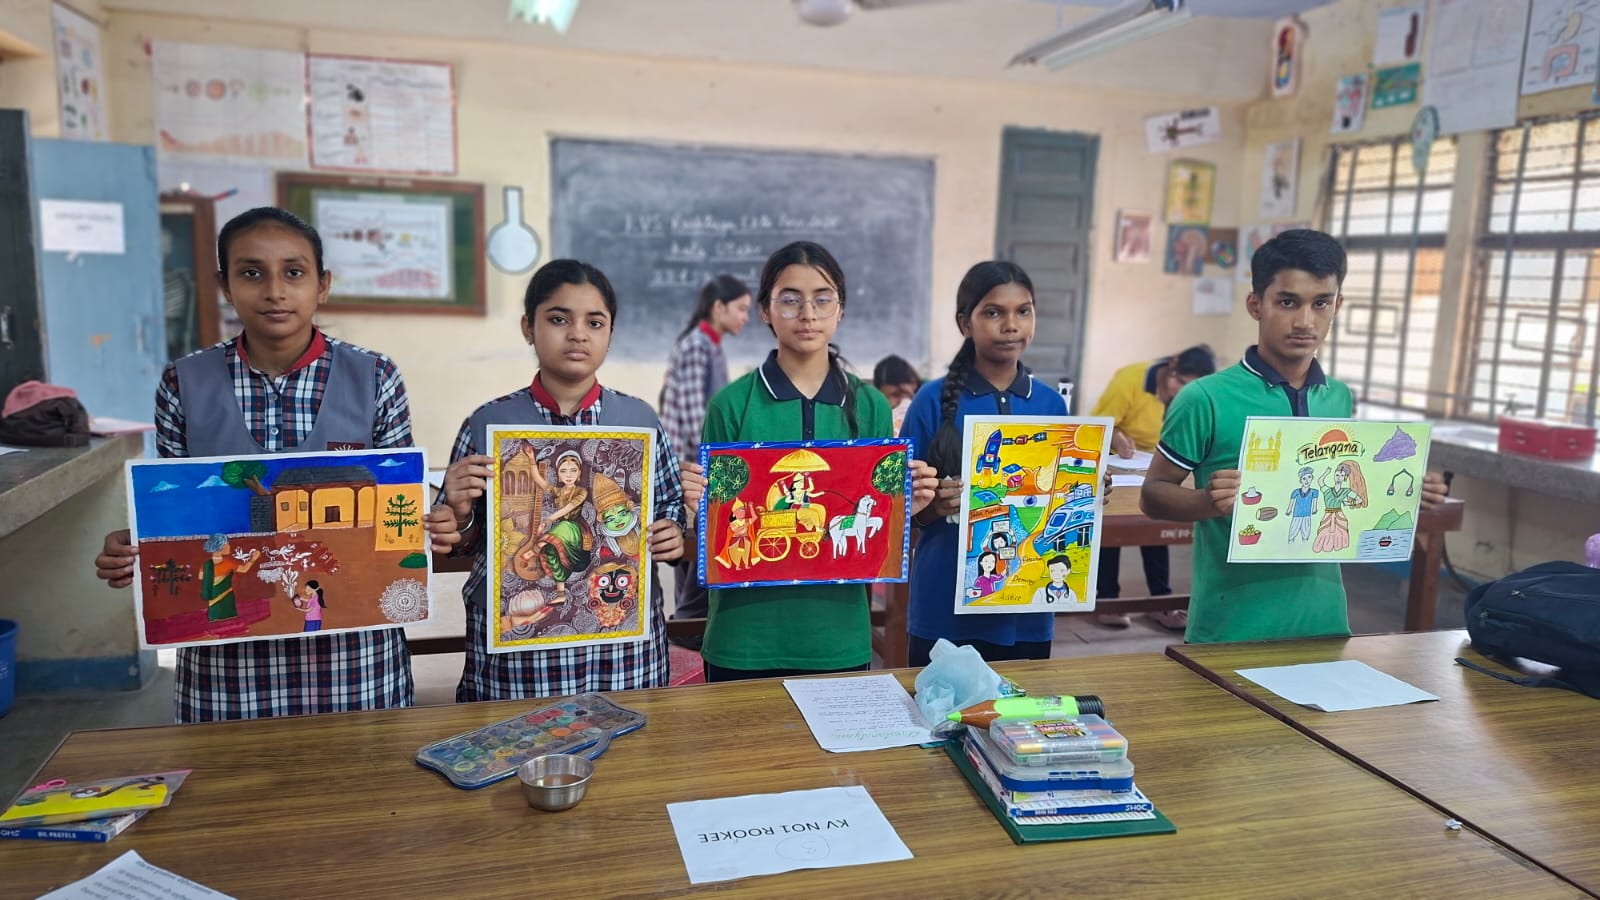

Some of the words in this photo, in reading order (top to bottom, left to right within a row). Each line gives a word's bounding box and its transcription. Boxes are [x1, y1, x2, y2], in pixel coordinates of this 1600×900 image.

[1301, 443, 1358, 459] Telangana
[780, 821, 820, 834] NO1
[827, 818, 849, 829] KV
[49, 831, 77, 839] PASTELS
[698, 826, 775, 843] ROOKEE
